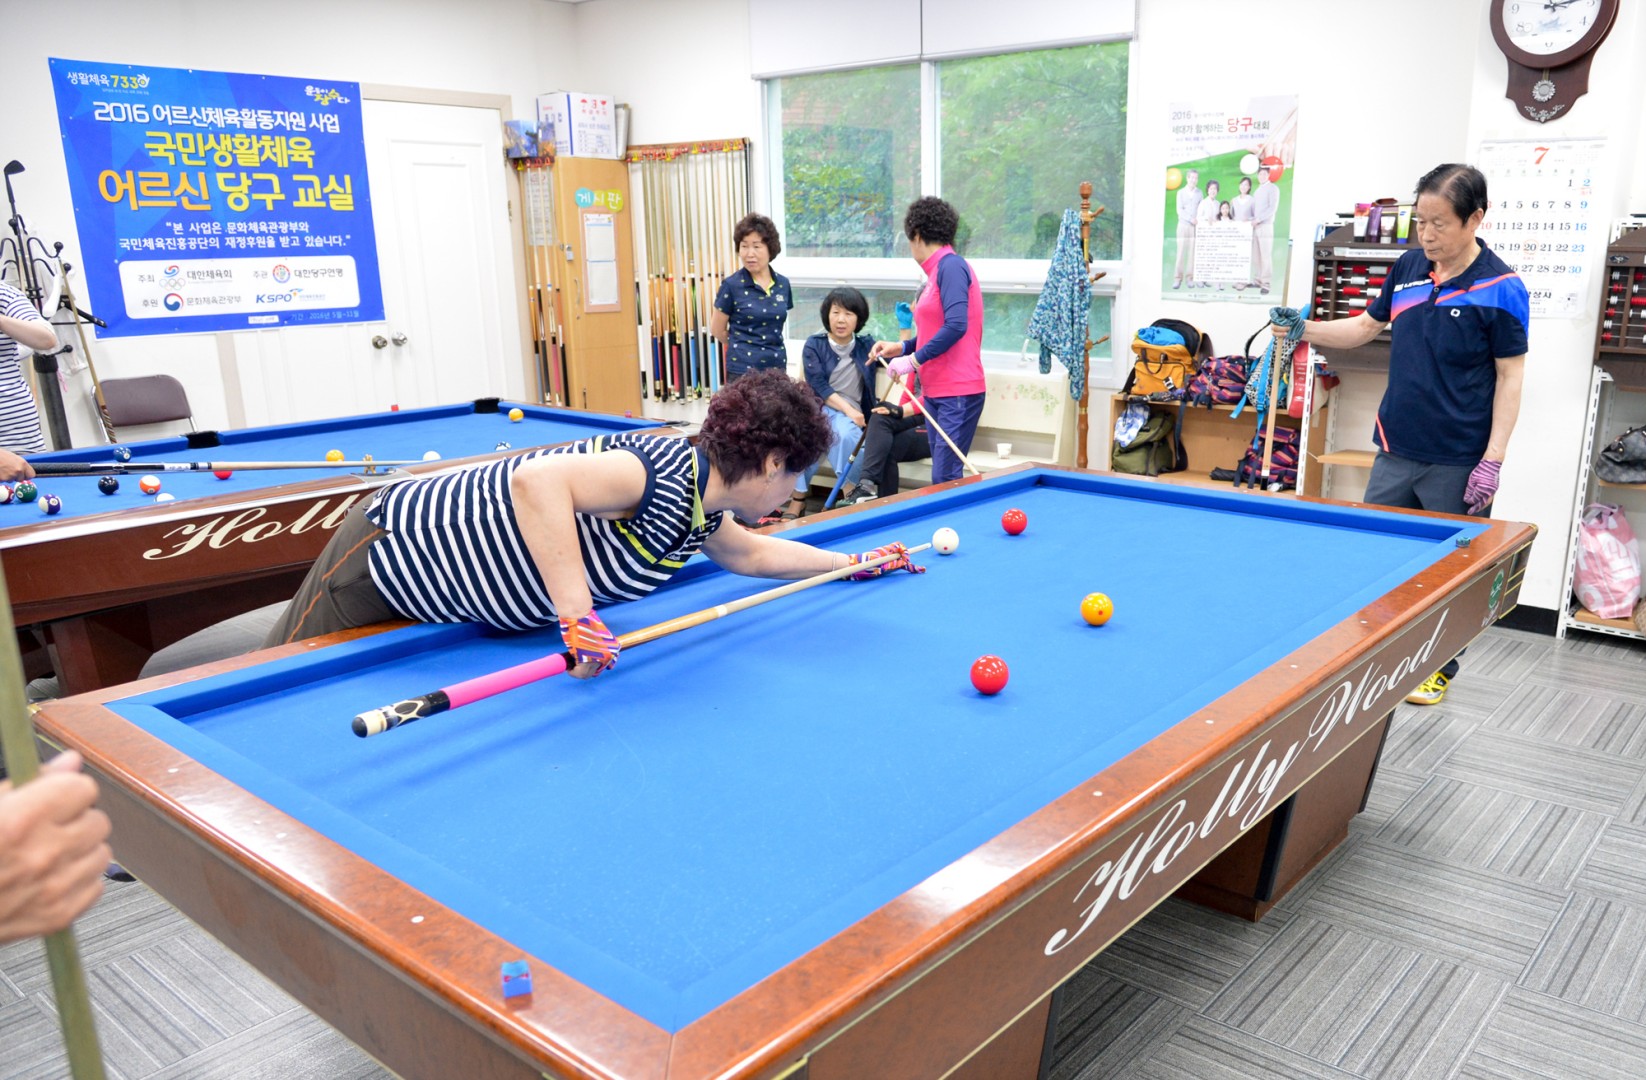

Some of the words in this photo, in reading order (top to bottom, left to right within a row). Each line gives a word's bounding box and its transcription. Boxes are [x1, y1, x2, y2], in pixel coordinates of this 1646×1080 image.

[67, 72, 110, 87] 생활체육
[93, 101, 150, 123] 2016
[152, 104, 307, 131] 어르신체육활동지원
[309, 113, 340, 133] 사업
[1172, 111, 1192, 120] 2016
[144, 131, 315, 168] 국민생활체육
[1534, 146, 1550, 165] 7
[1583, 178, 1591, 187] 2
[98, 169, 212, 211] 어르신
[216, 172, 285, 212] 당구
[292, 174, 354, 211] 교실
[577, 191, 621, 209] 게시판
[1500, 200, 1507, 209] 4
[1516, 200, 1523, 209] 5
[1532, 200, 1539, 209] 6
[1548, 200, 1555, 209] 7
[1564, 200, 1571, 209] 8
[1580, 200, 1588, 209] 9
[189, 222, 222, 235] 사업은
[226, 221, 309, 234] 문화체육관광부와
[1481, 221, 1492, 230] 10
[1496, 221, 1507, 230] 11
[1511, 221, 1523, 230] 12
[1527, 221, 1539, 230] 13
[1543, 221, 1554, 230] 14
[1559, 221, 1571, 231] 15
[1575, 222, 1587, 231] 16
[119, 236, 220, 251] 국민체육진흥공단의
[225, 236, 275, 249] 재정후원을
[279, 236, 300, 248] 받고
[1494, 242, 1505, 251] 18
[1509, 242, 1520, 251] 19
[1524, 242, 1536, 251] 20
[1540, 243, 1552, 252] 21
[1555, 243, 1568, 252] 22
[1571, 243, 1585, 252] 23
[186, 269, 232, 280] 대한체육회
[294, 268, 343, 279] 대한당구연맹
[1521, 264, 1534, 273] 27
[1537, 264, 1549, 273] 28
[1553, 264, 1566, 273] 29
[1568, 265, 1582, 274] 30
[187, 295, 242, 306] 문화체육관광부
[256, 293, 292, 304] KSPO
[142, 493, 360, 560] Holl
[1044, 739, 1300, 956] Holly
[1309, 607, 1449, 752] Wood
